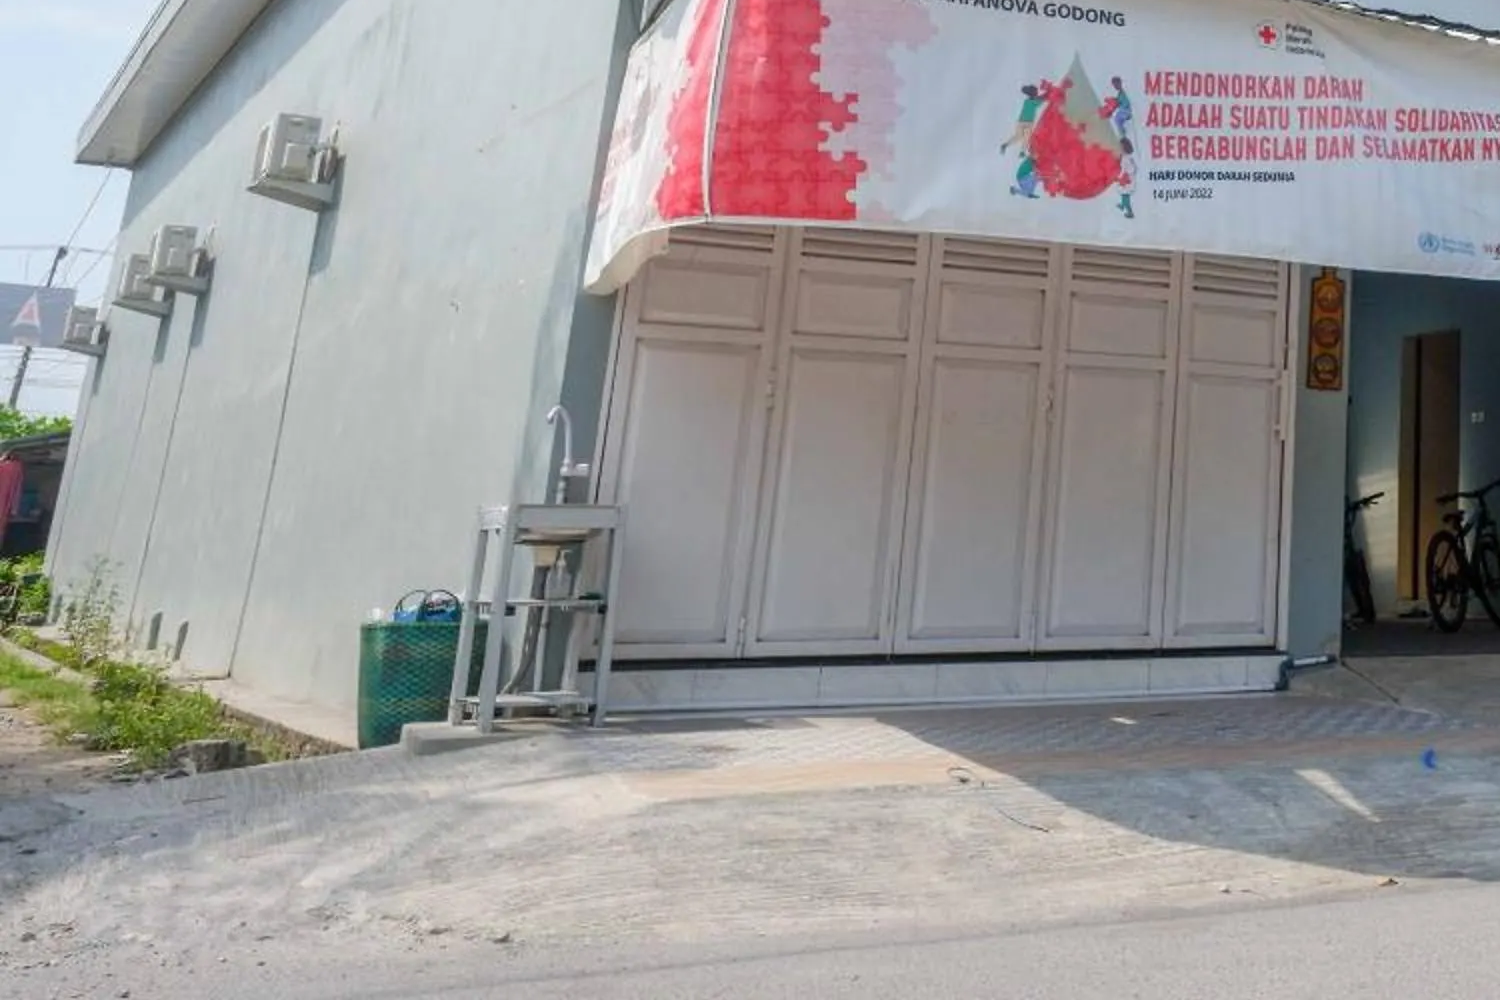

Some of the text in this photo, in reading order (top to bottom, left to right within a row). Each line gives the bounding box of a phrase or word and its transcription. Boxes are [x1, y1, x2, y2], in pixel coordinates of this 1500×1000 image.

[1043, 3, 1126, 27] GODONG
[1144, 71, 1364, 102] MENDONORKAN DARAH
[1146, 102, 1223, 129] ADALAH
[1229, 104, 1291, 131] SUATU
[1297, 105, 1387, 132] TINDAKAN
[1150, 134, 1307, 161] BERGABUNGLAH
[1315, 135, 1354, 160] DAN
[1362, 134, 1475, 162] SELAMATKAN
